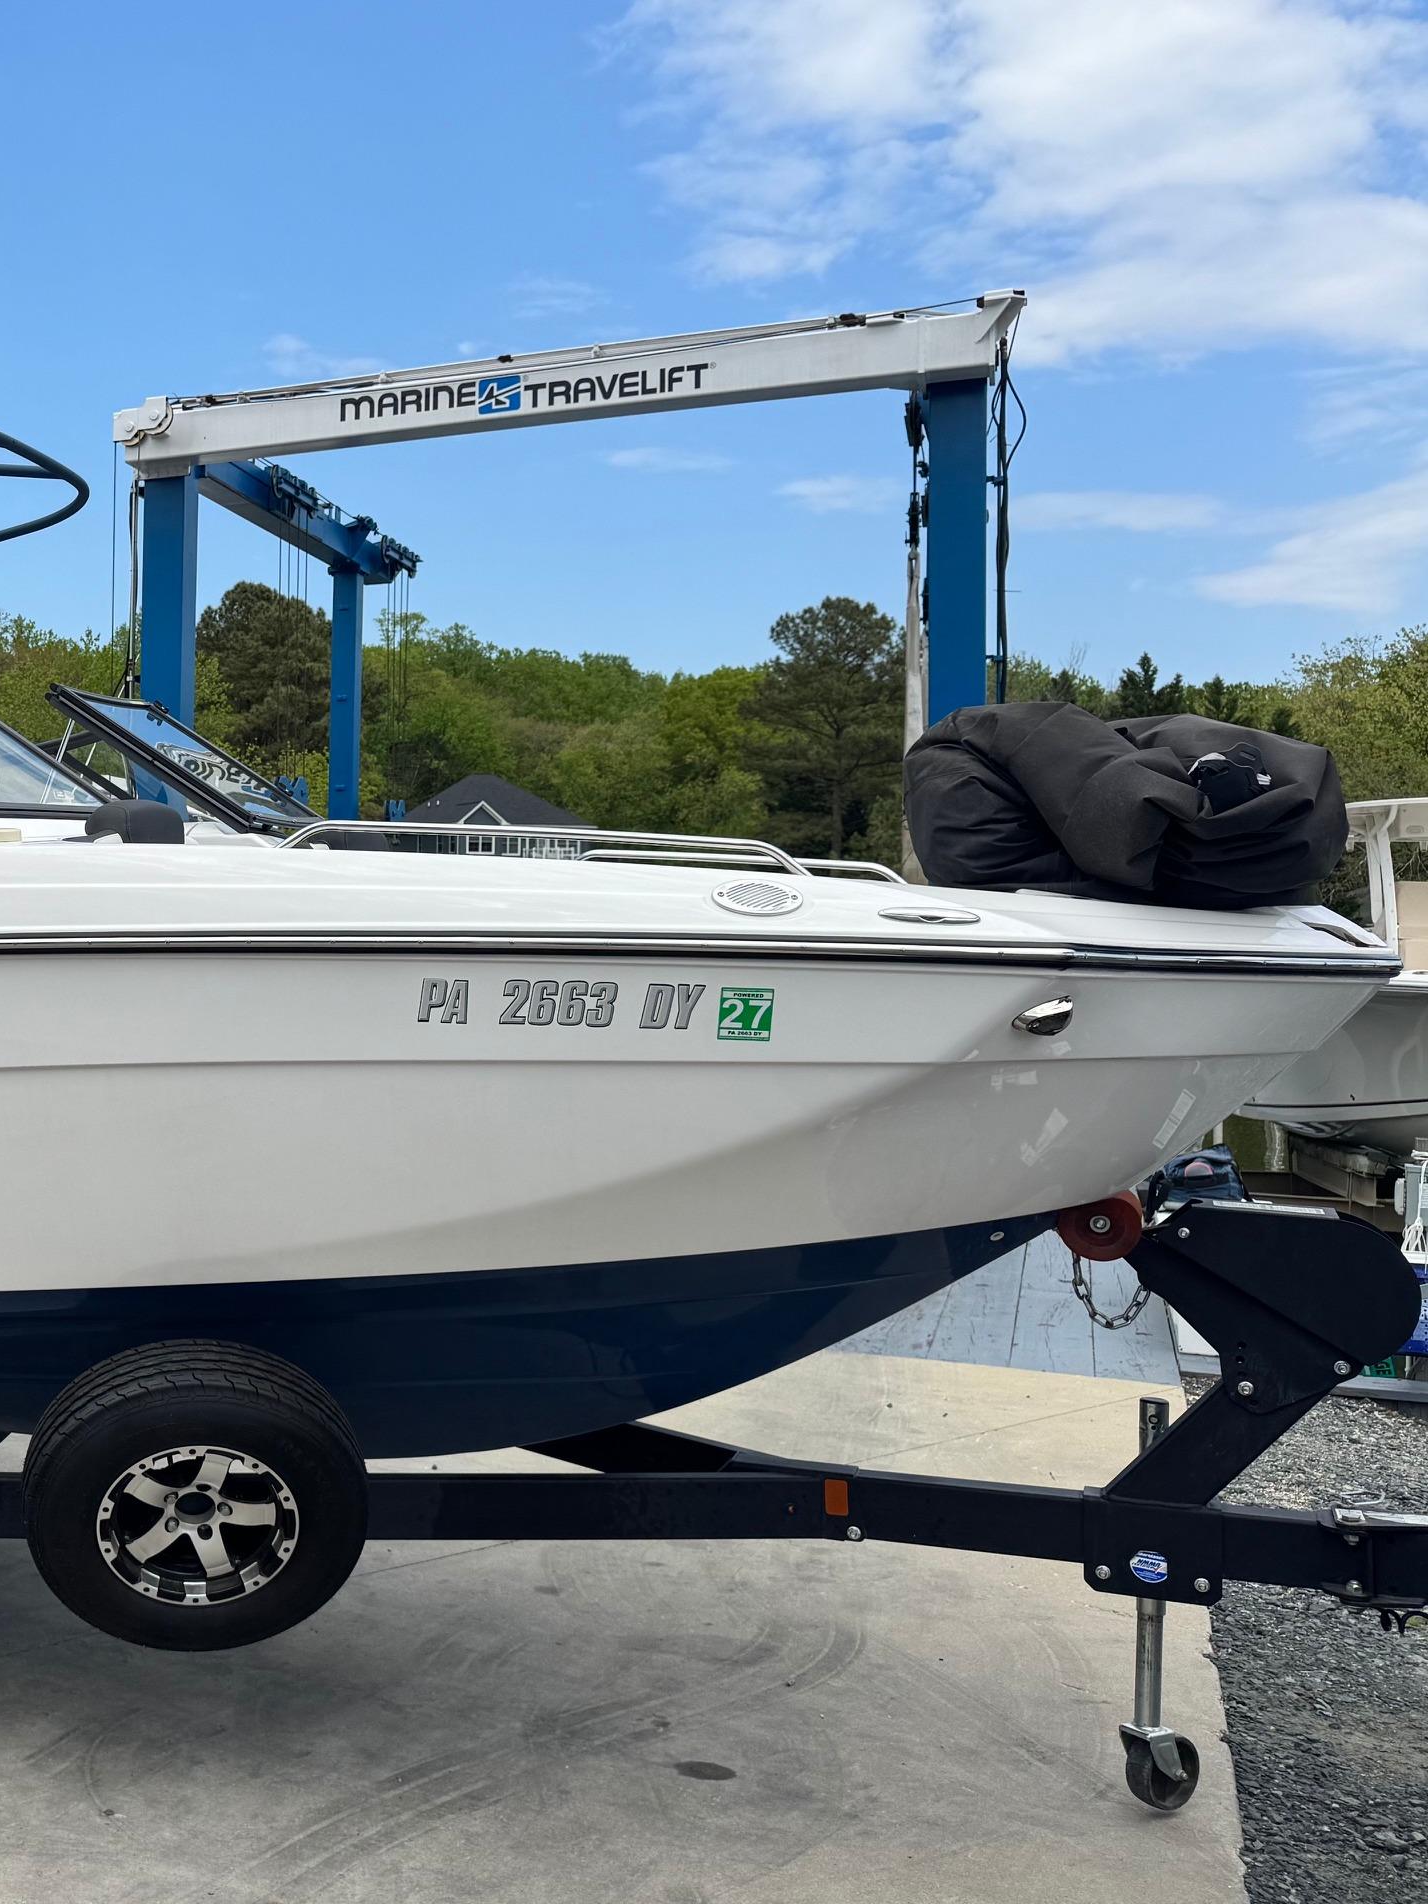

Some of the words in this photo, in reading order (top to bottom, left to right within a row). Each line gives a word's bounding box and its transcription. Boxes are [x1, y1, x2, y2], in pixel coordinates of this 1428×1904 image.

[340, 381, 477, 422] MARINE
[524, 362, 710, 408] TRAVELIFT
[417, 977, 469, 1025] PA
[499, 979, 619, 1028] 2663
[639, 983, 707, 1030] DY
[719, 998, 772, 1029] 27
